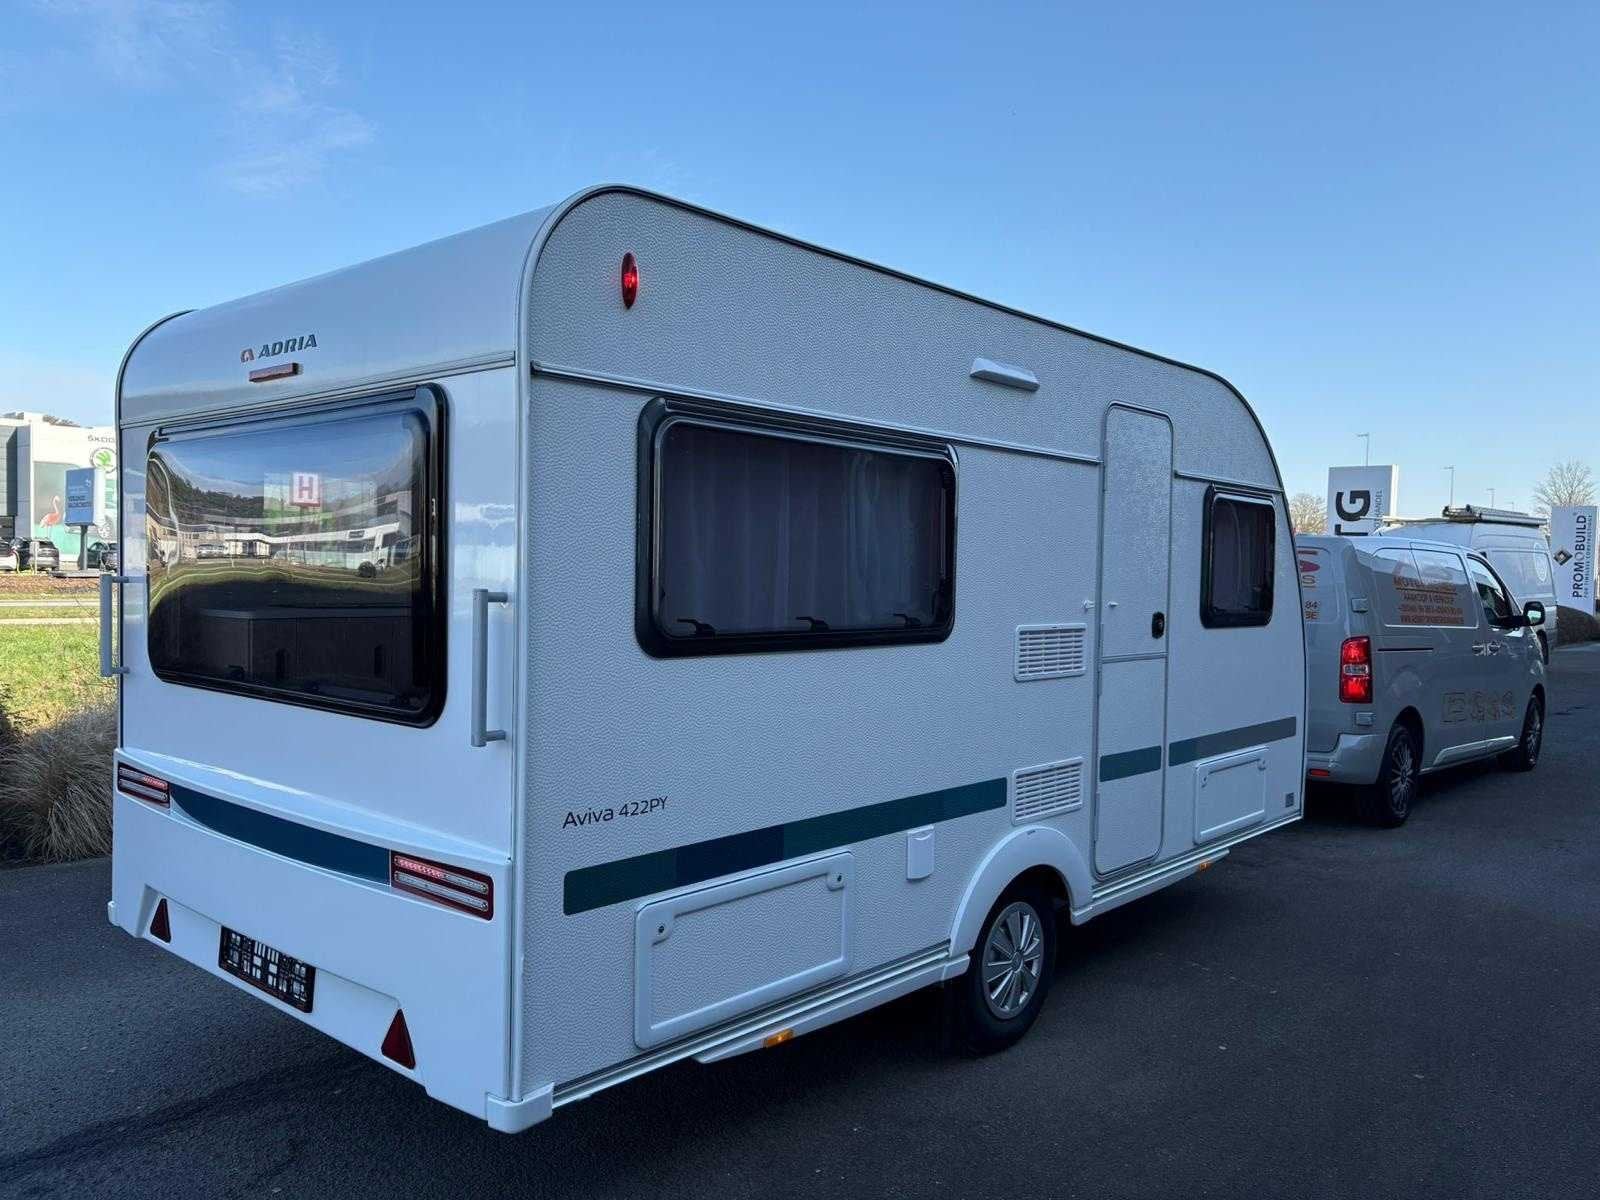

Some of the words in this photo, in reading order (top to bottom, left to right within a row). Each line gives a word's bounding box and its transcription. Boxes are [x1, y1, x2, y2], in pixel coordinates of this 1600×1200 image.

[258, 334, 317, 359] ADRIA
[1572, 515, 1587, 598] PROMOBUILD
[562, 808, 614, 829] Aviva
[618, 796, 668, 817] 422PY
